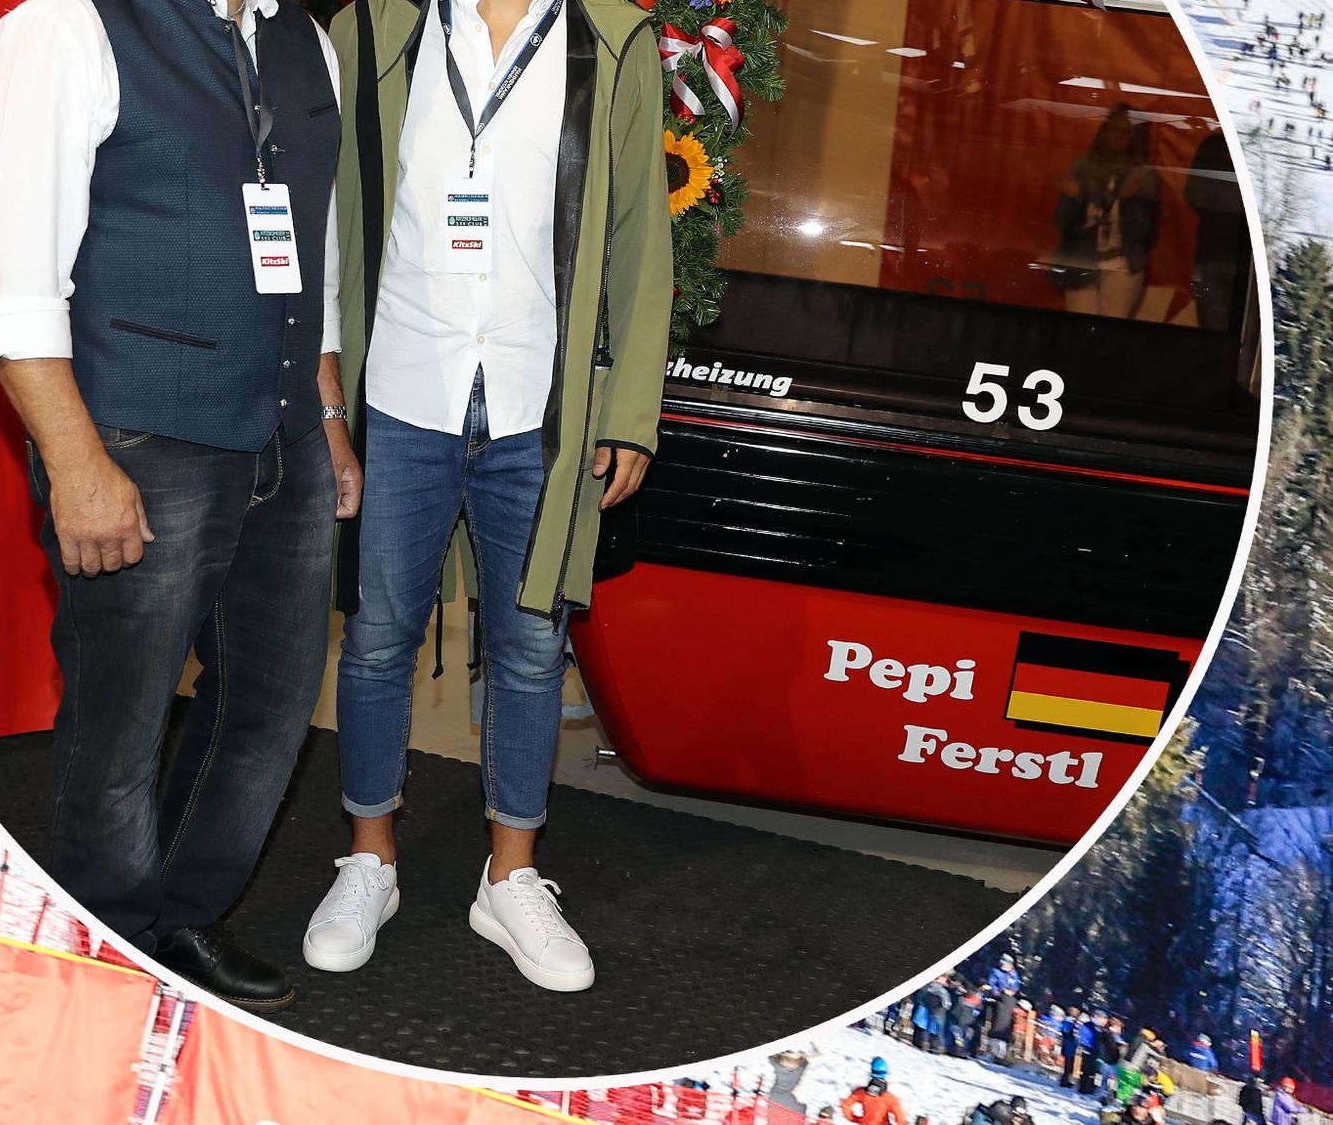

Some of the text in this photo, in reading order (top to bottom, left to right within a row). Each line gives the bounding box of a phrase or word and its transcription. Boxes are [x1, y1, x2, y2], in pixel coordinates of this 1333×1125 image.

[261, 257, 288, 265] KitzSki
[961, 361, 1065, 430] 53
[823, 639, 976, 703] Pepi
[897, 724, 1103, 788] Ferstl
